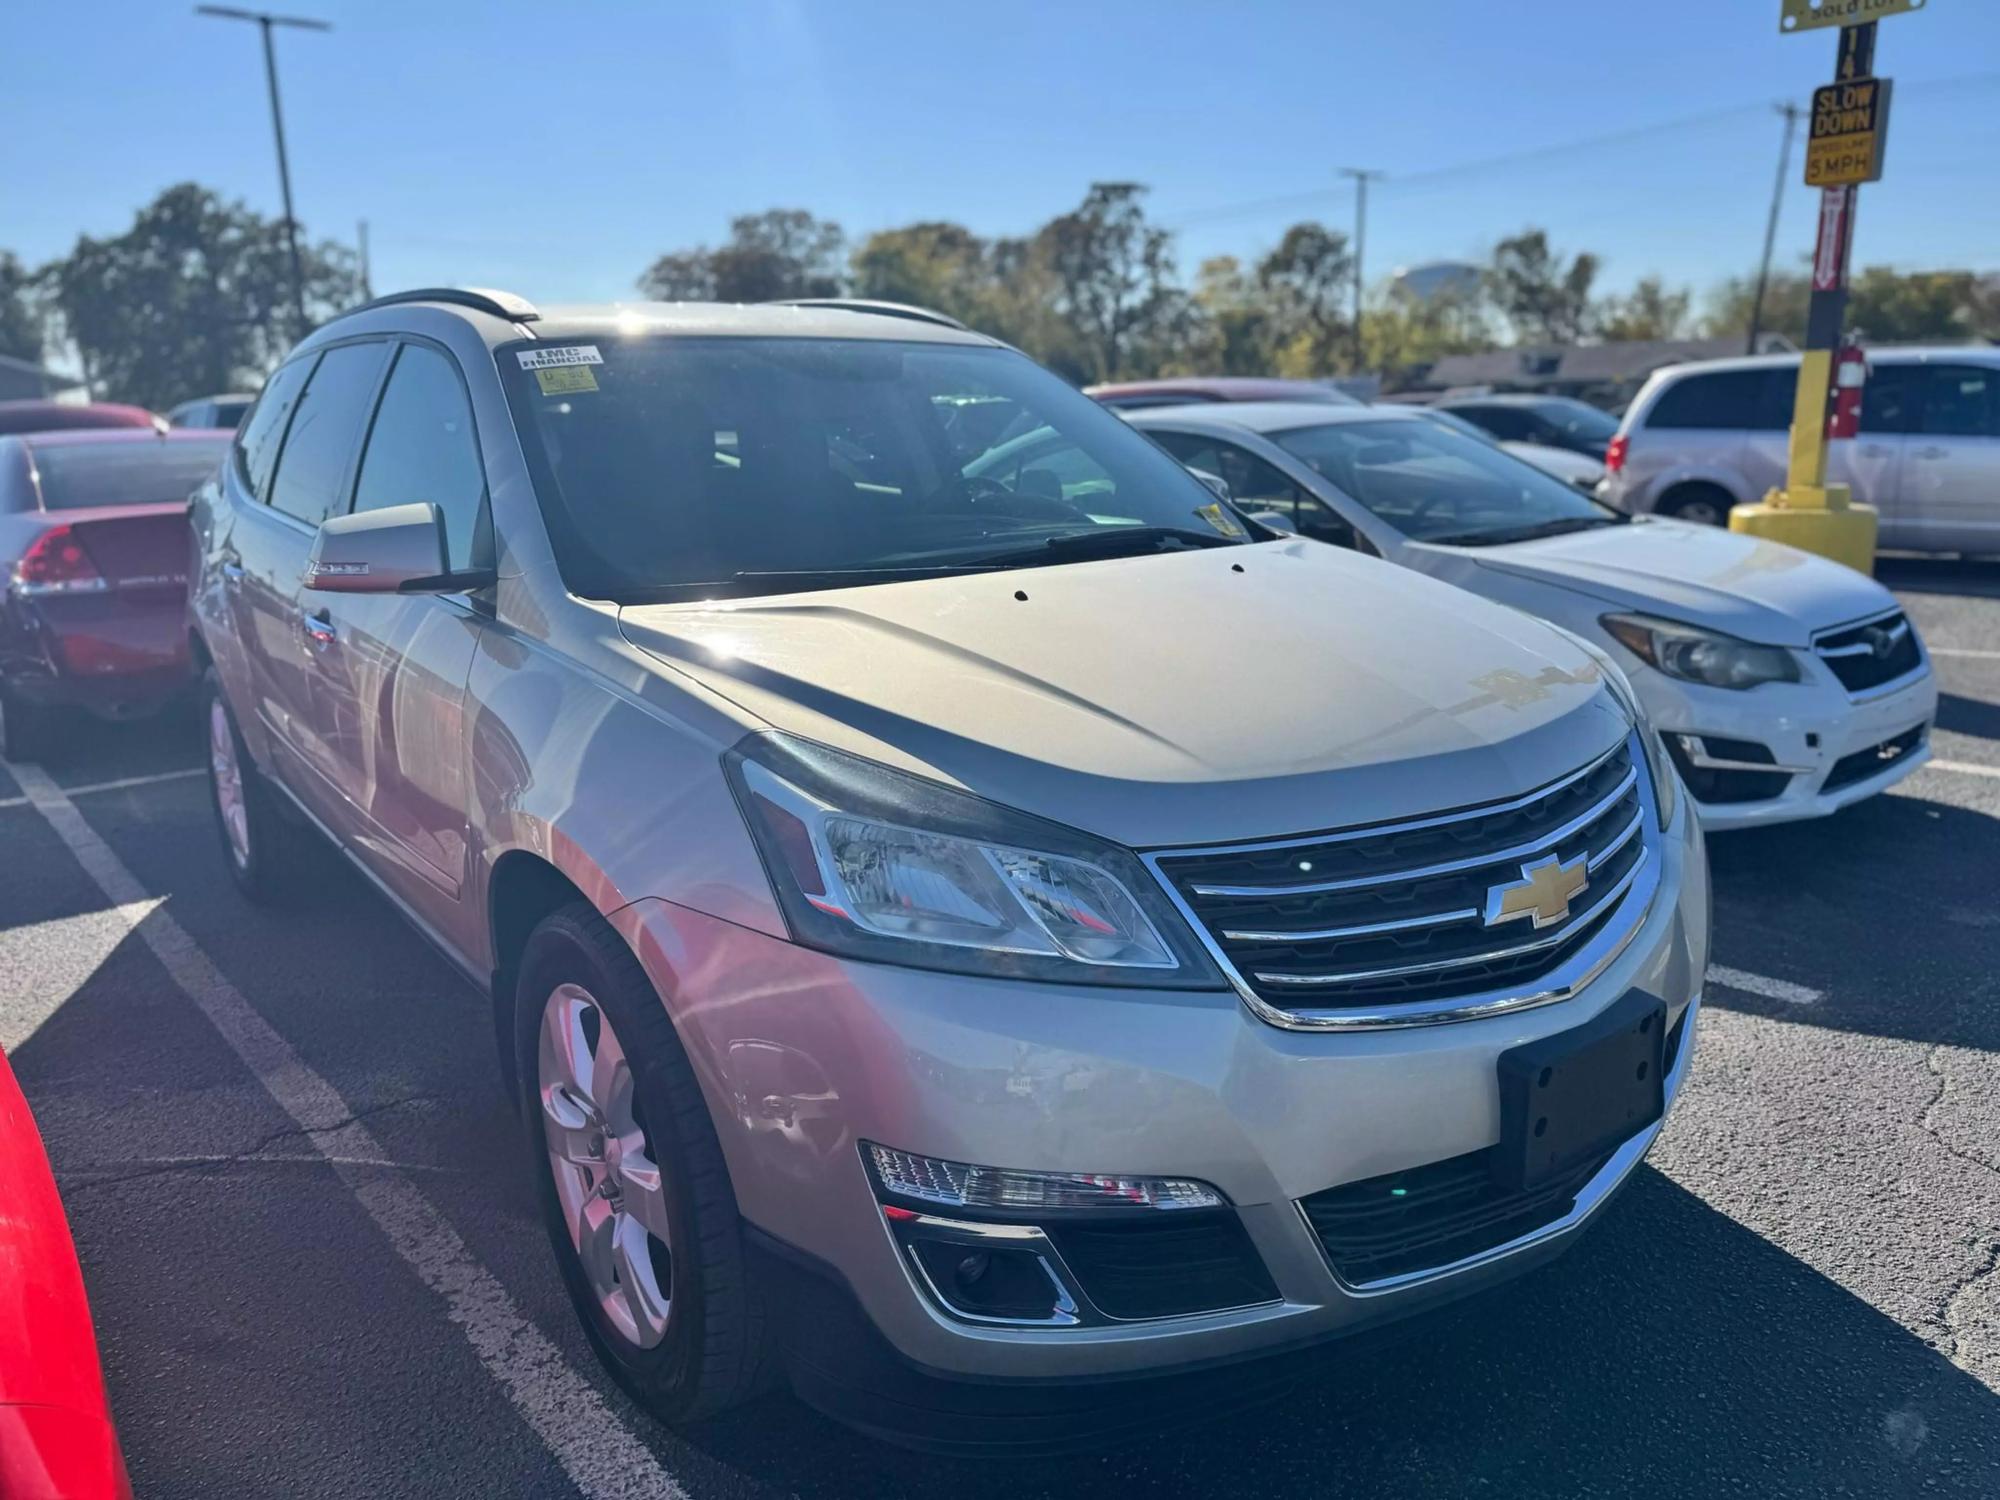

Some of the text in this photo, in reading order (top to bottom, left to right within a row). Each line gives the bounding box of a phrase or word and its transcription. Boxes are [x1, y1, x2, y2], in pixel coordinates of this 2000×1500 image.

[1818, 85, 1874, 113] SLOW
[1814, 108, 1871, 137] DOWN
[1810, 153, 1867, 178] 5 MPH
[522, 355, 600, 368] FINANCIAL
